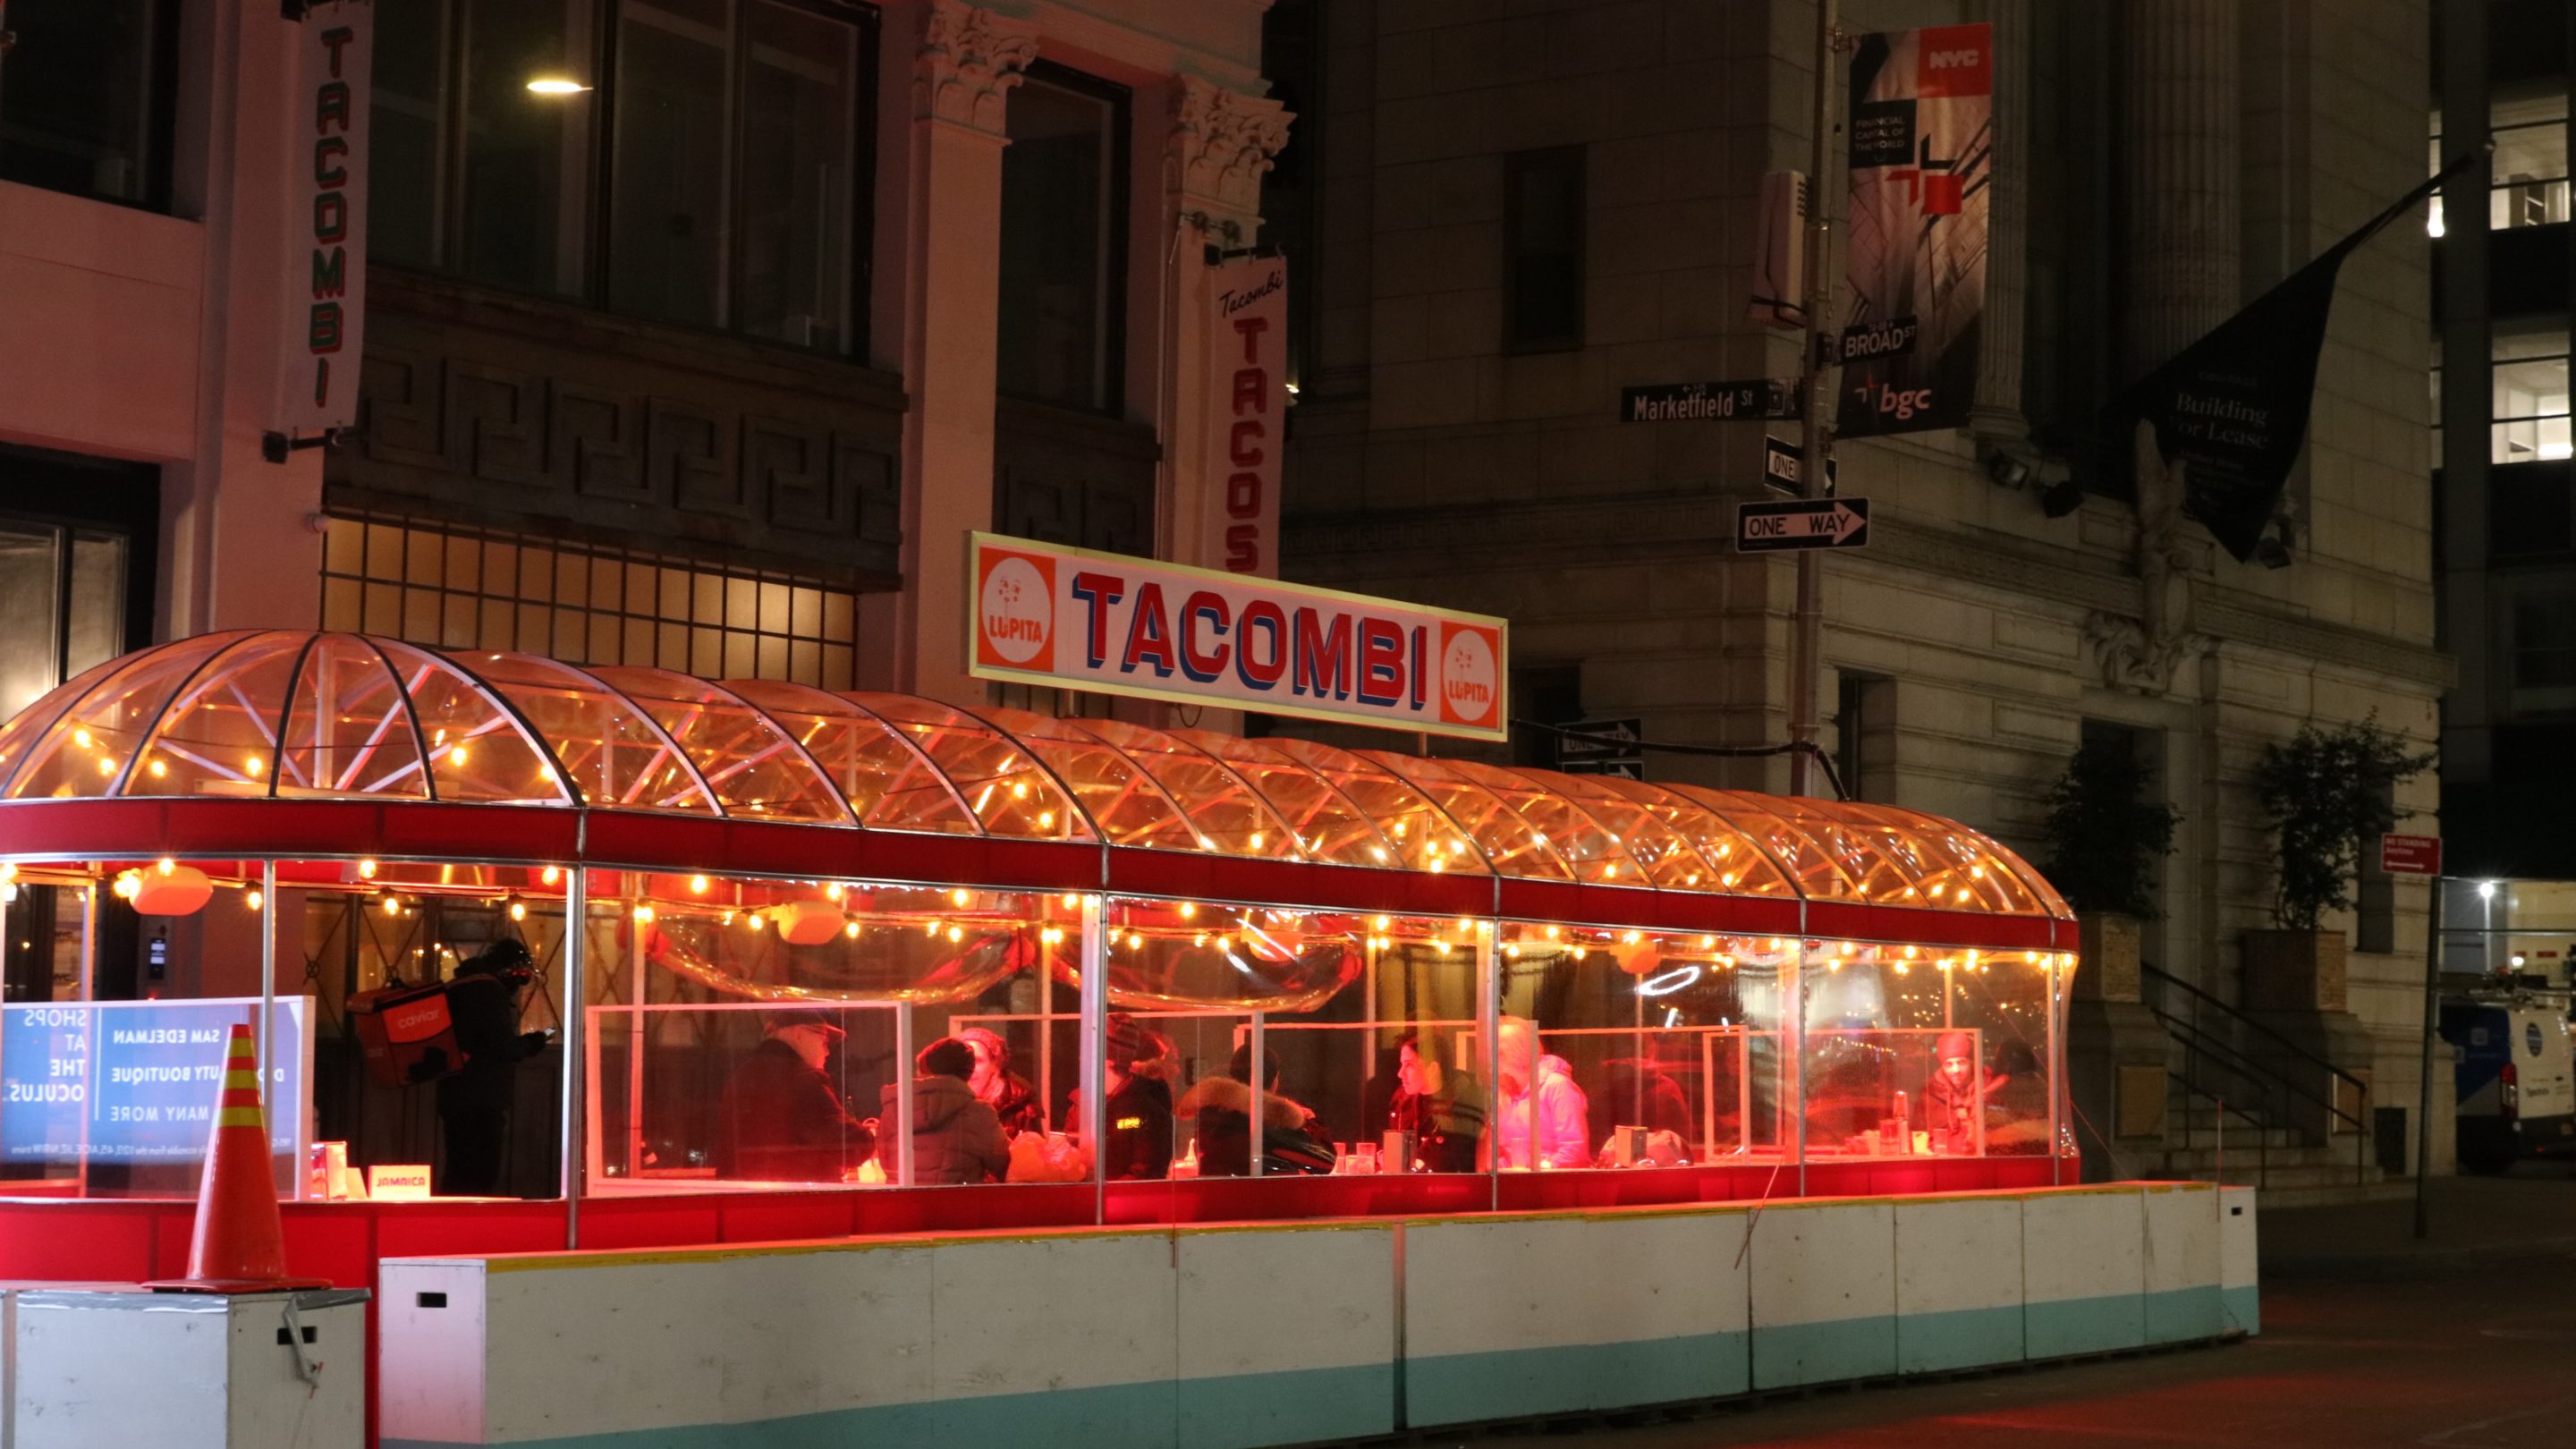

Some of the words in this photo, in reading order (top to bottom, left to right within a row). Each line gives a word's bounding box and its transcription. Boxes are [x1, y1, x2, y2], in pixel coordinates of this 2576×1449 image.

[1928, 49, 1979, 70] NYC
[1892, 127, 1904, 137] OF
[309, 26, 353, 409] TACOMBI
[1219, 270, 1284, 318] Tacombi
[1844, 327, 1904, 359] BROAD
[1904, 325, 1916, 338] ST
[1633, 390, 1734, 421] Marketfield
[1741, 388, 1754, 407] St
[1879, 383, 1933, 420] bgc
[2175, 392, 2269, 428] Building
[1225, 316, 1268, 574] TACOS
[2207, 421, 2268, 449] Lease
[1774, 454, 1794, 479] ONE
[1749, 517, 1787, 536] ONE
[1809, 513, 1851, 533] WAY
[989, 614, 1043, 643] LUPITA
[1073, 572, 1427, 711] TACOMBI
[1449, 680, 1489, 704] LUPITA
[397, 1008, 440, 1030] caviar
[376, 1176, 426, 1187] JAMAICA
